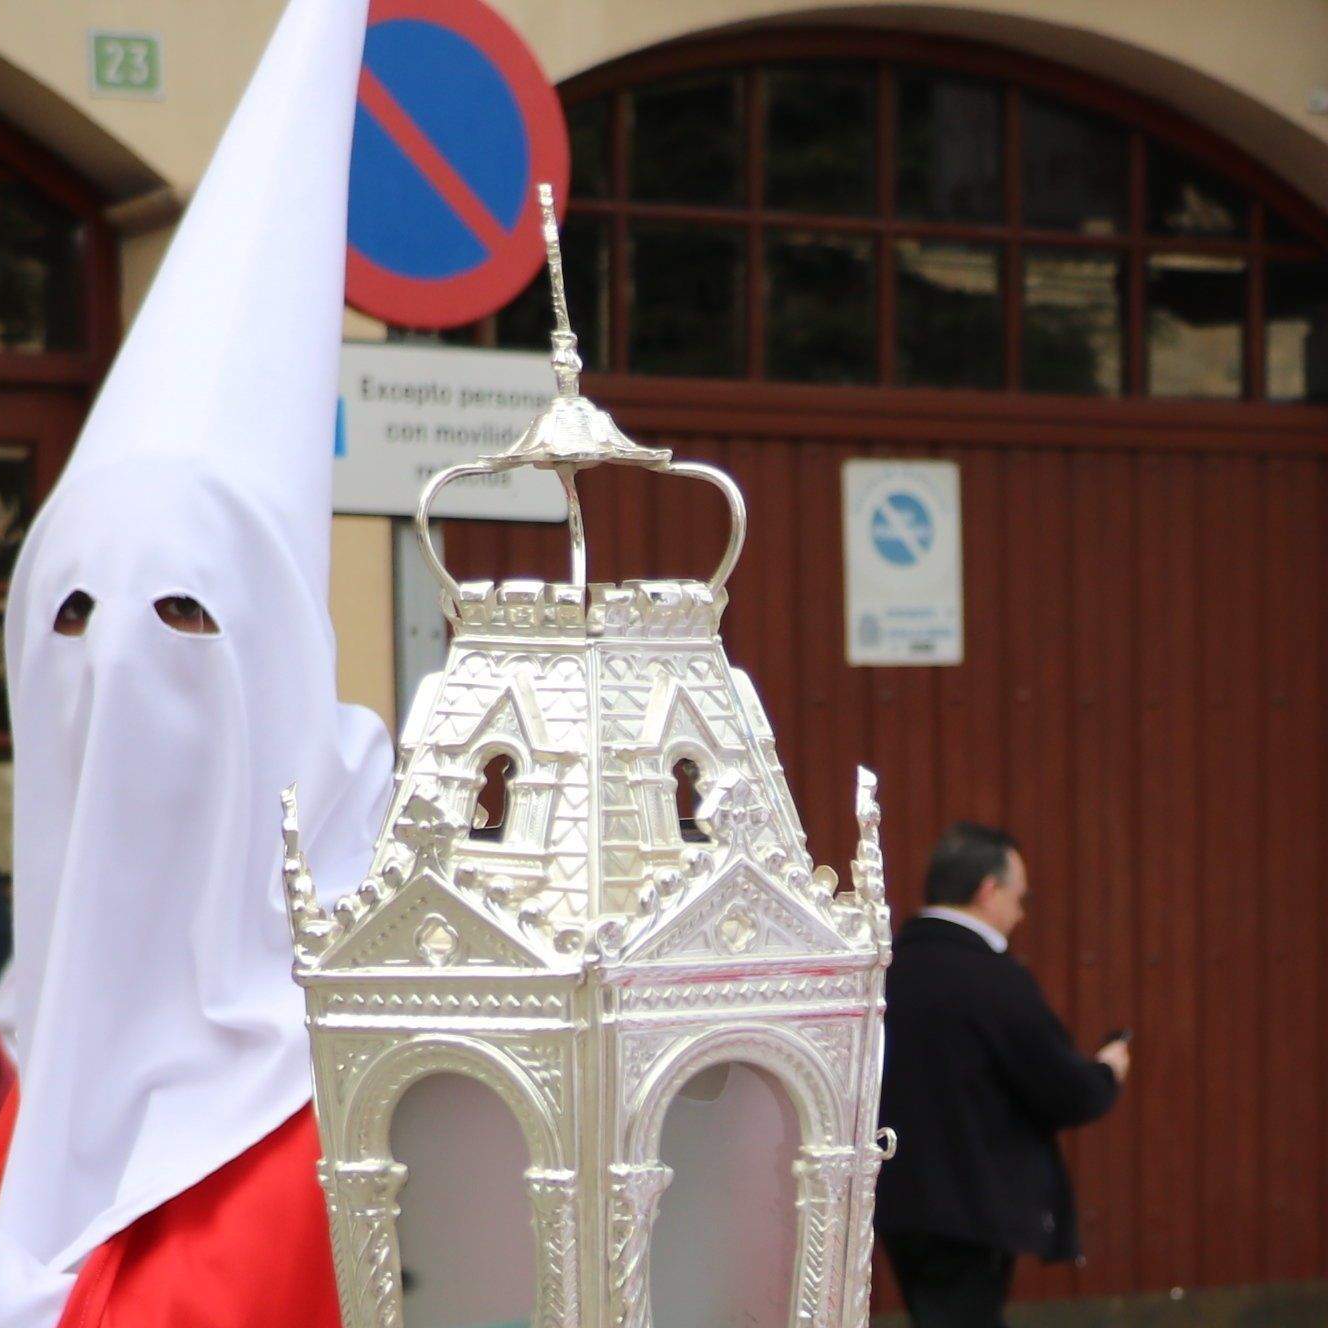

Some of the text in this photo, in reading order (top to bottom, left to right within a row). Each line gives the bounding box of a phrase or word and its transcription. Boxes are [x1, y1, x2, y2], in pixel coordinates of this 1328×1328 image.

[106, 44, 149, 84] 23
[361, 376, 452, 406] Excepto
[386, 424, 522, 446] con movilid
